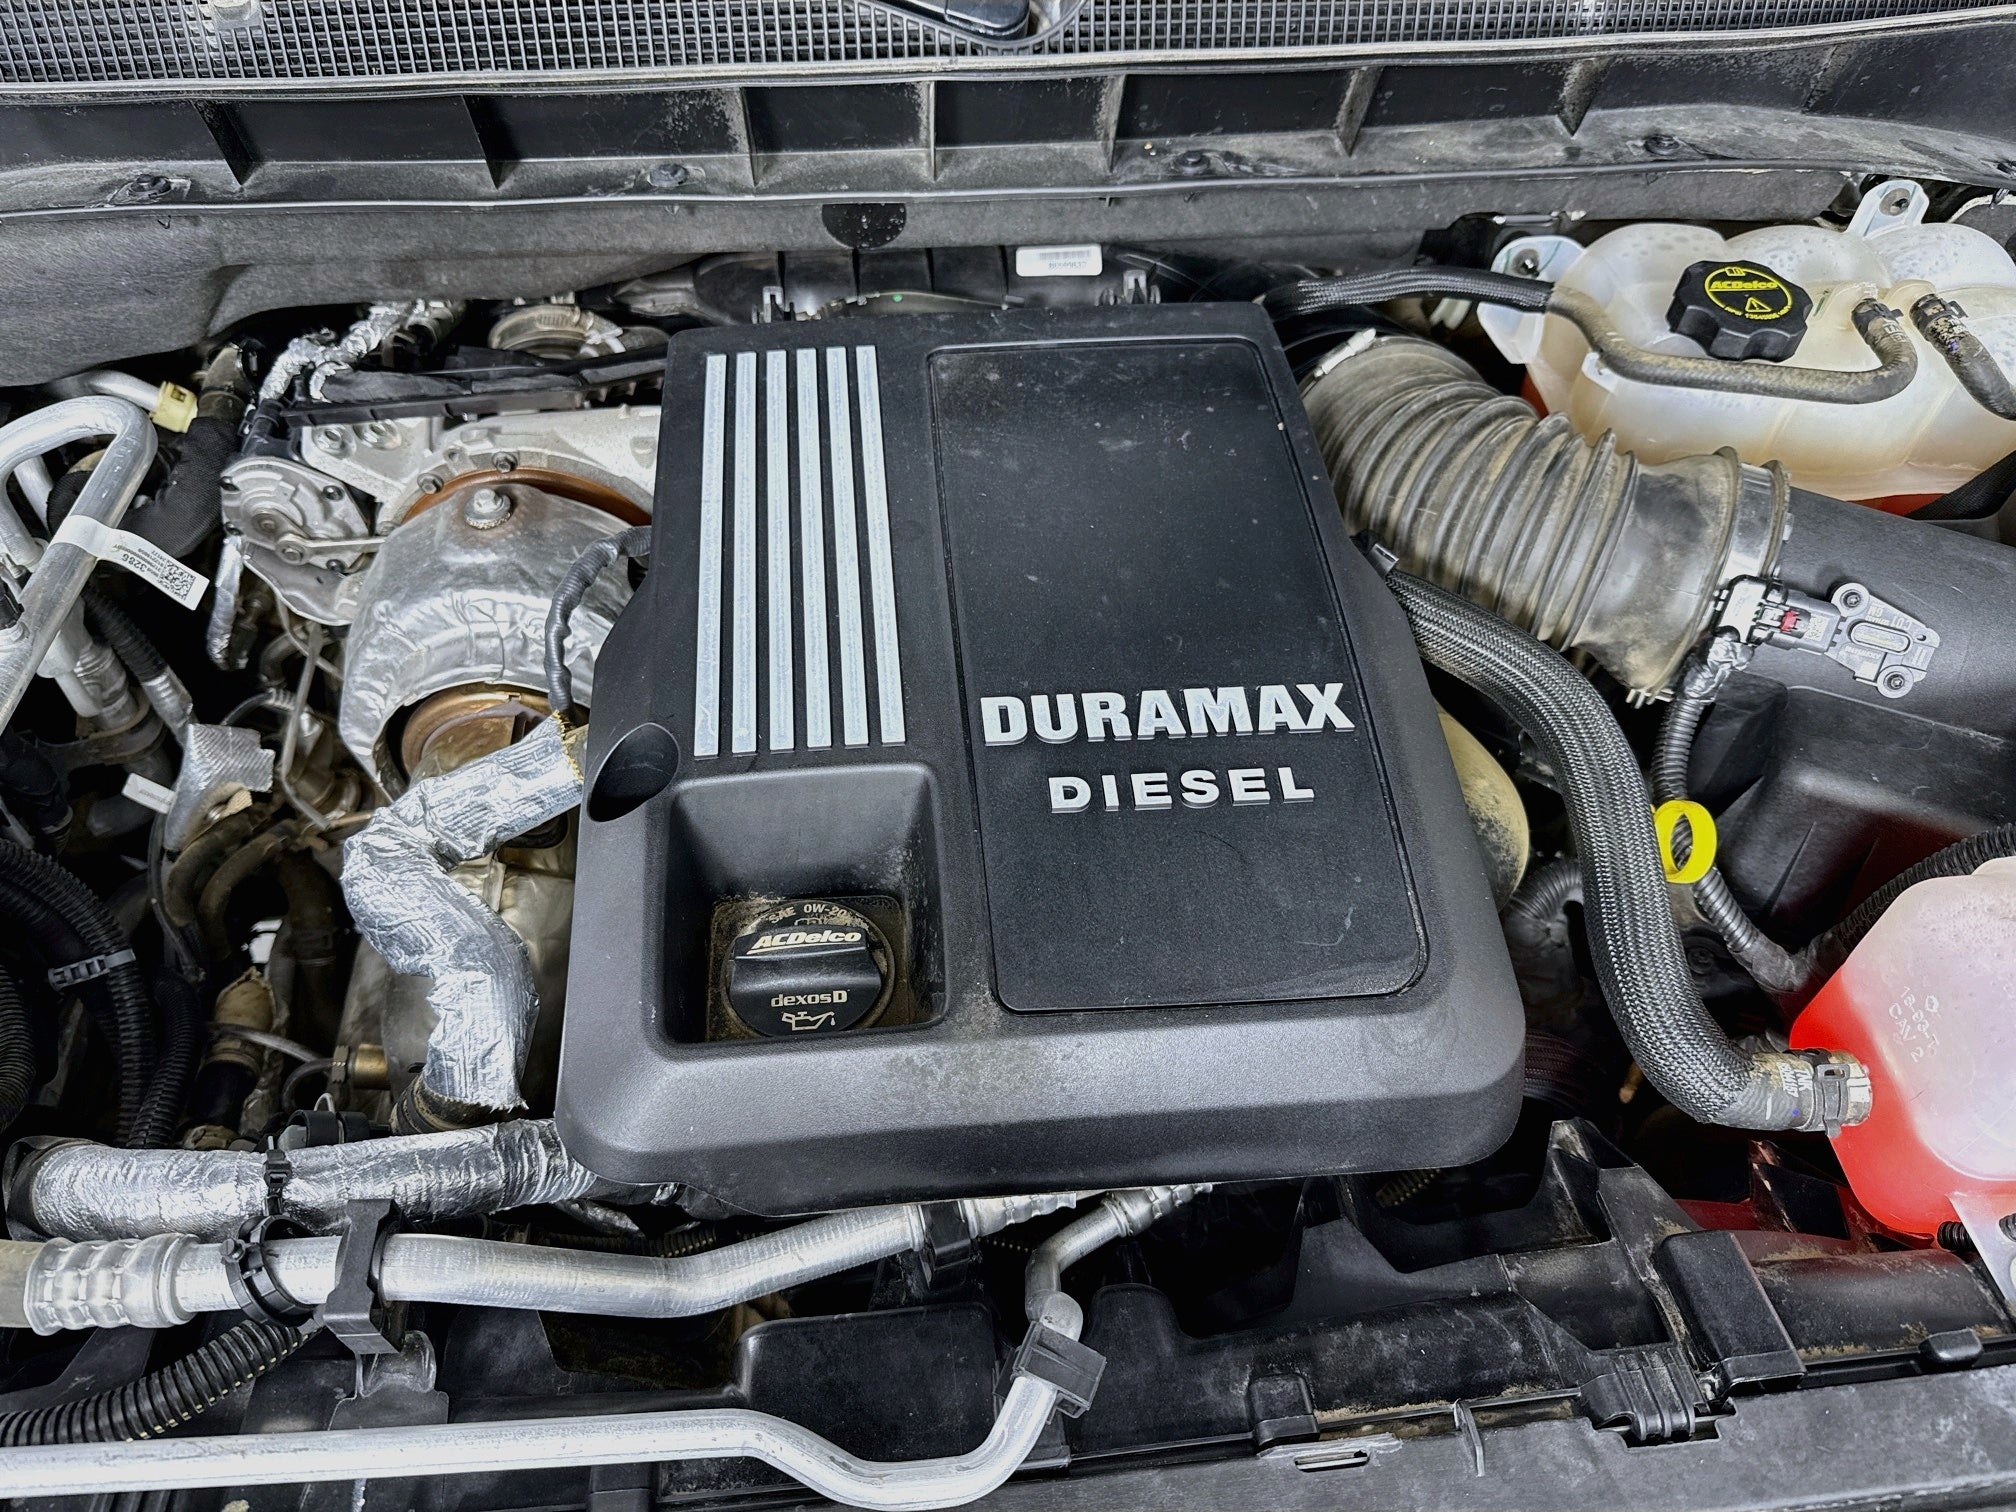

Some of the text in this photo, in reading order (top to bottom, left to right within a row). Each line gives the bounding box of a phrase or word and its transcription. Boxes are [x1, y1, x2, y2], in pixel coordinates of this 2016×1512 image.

[1710, 280, 1778, 289] ACDelco
[121, 553, 147, 572] 3286
[980, 683, 1355, 747] DURAMAX
[1048, 766, 1315, 814] DIESEL
[768, 903, 848, 924] SAE 0W-20
[751, 929, 862, 950] ACDelco
[770, 989, 849, 1008] dexosD
